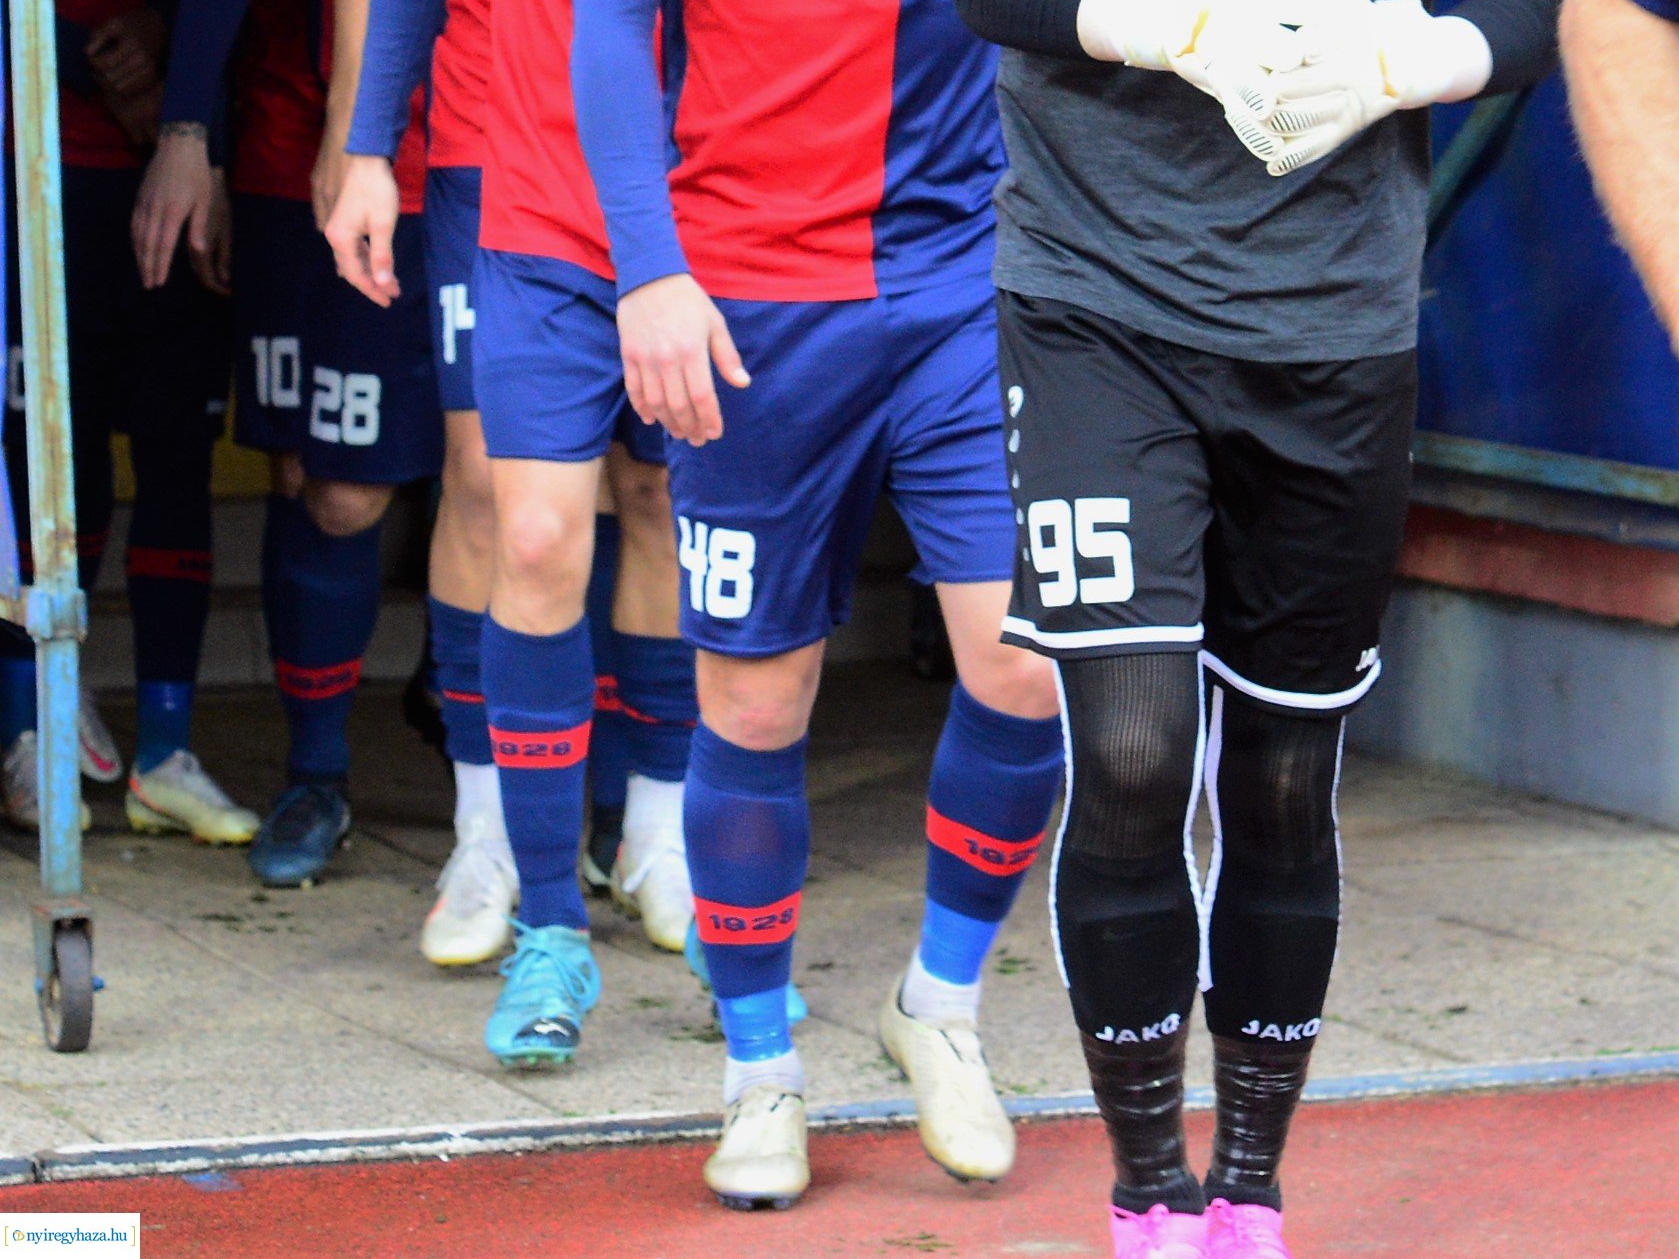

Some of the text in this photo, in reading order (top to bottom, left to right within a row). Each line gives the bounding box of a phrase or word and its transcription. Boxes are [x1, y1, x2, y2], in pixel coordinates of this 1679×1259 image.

[251, 336, 300, 409] 10
[309, 365, 382, 446] 28
[678, 515, 756, 619] 48
[1028, 497, 1135, 607] 95
[709, 908, 794, 932] 1928
[1096, 1013, 1182, 1044] JAKO
[1241, 1017, 1322, 1042] JAKO
